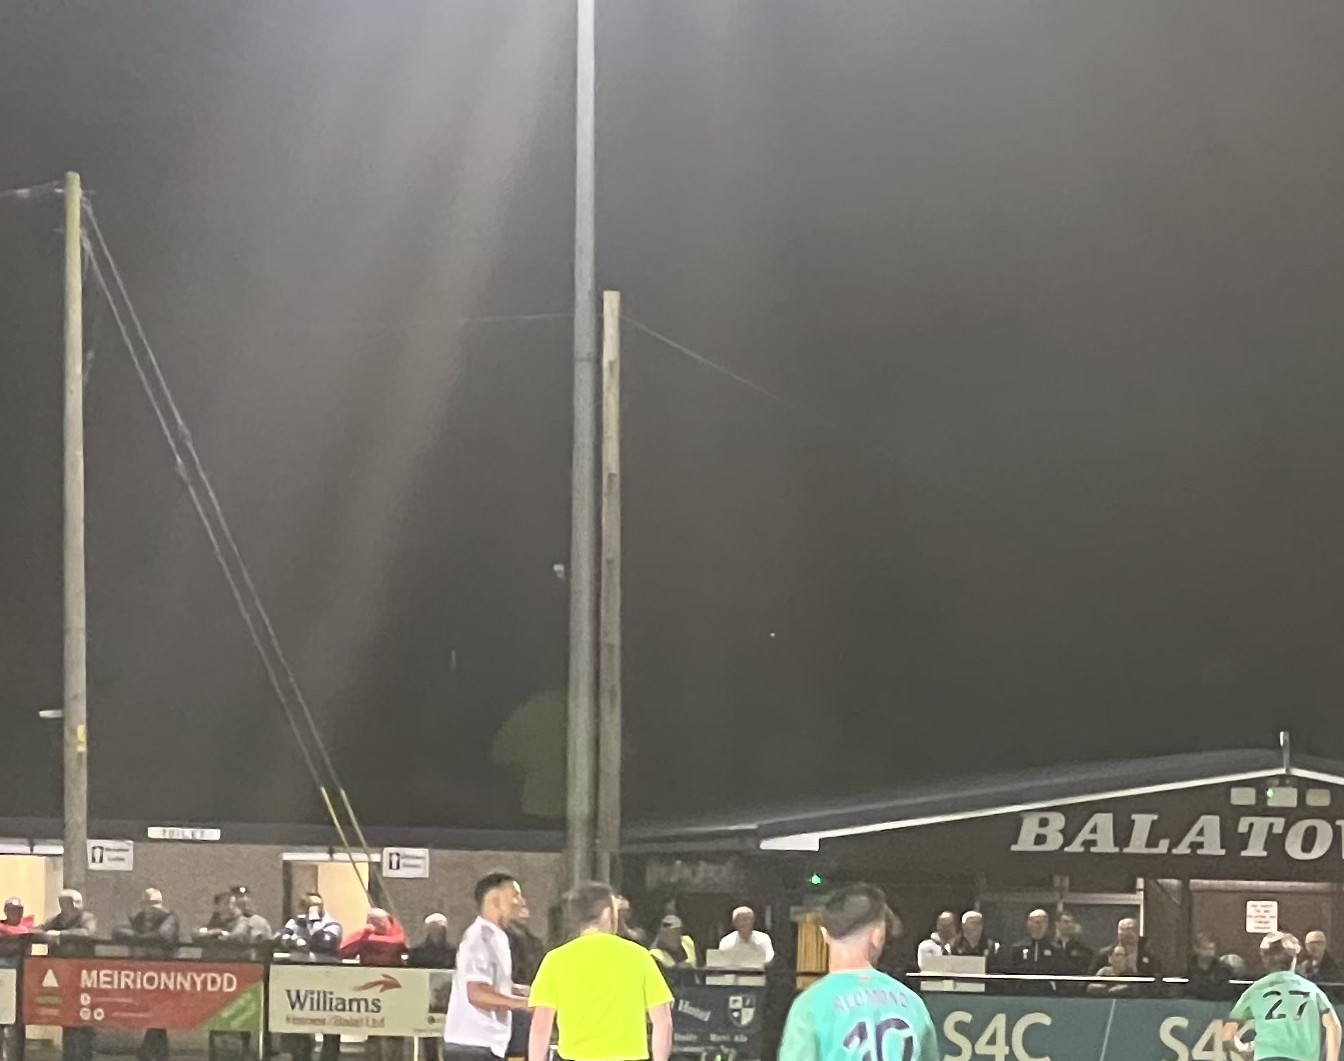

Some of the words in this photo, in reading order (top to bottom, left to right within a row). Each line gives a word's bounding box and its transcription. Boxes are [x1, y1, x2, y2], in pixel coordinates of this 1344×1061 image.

[1010, 811, 1226, 855] BALA
[80, 969, 237, 992] MEIRIONNYDD
[285, 989, 382, 1013] Williams
[1262, 990, 1311, 1021] 27
